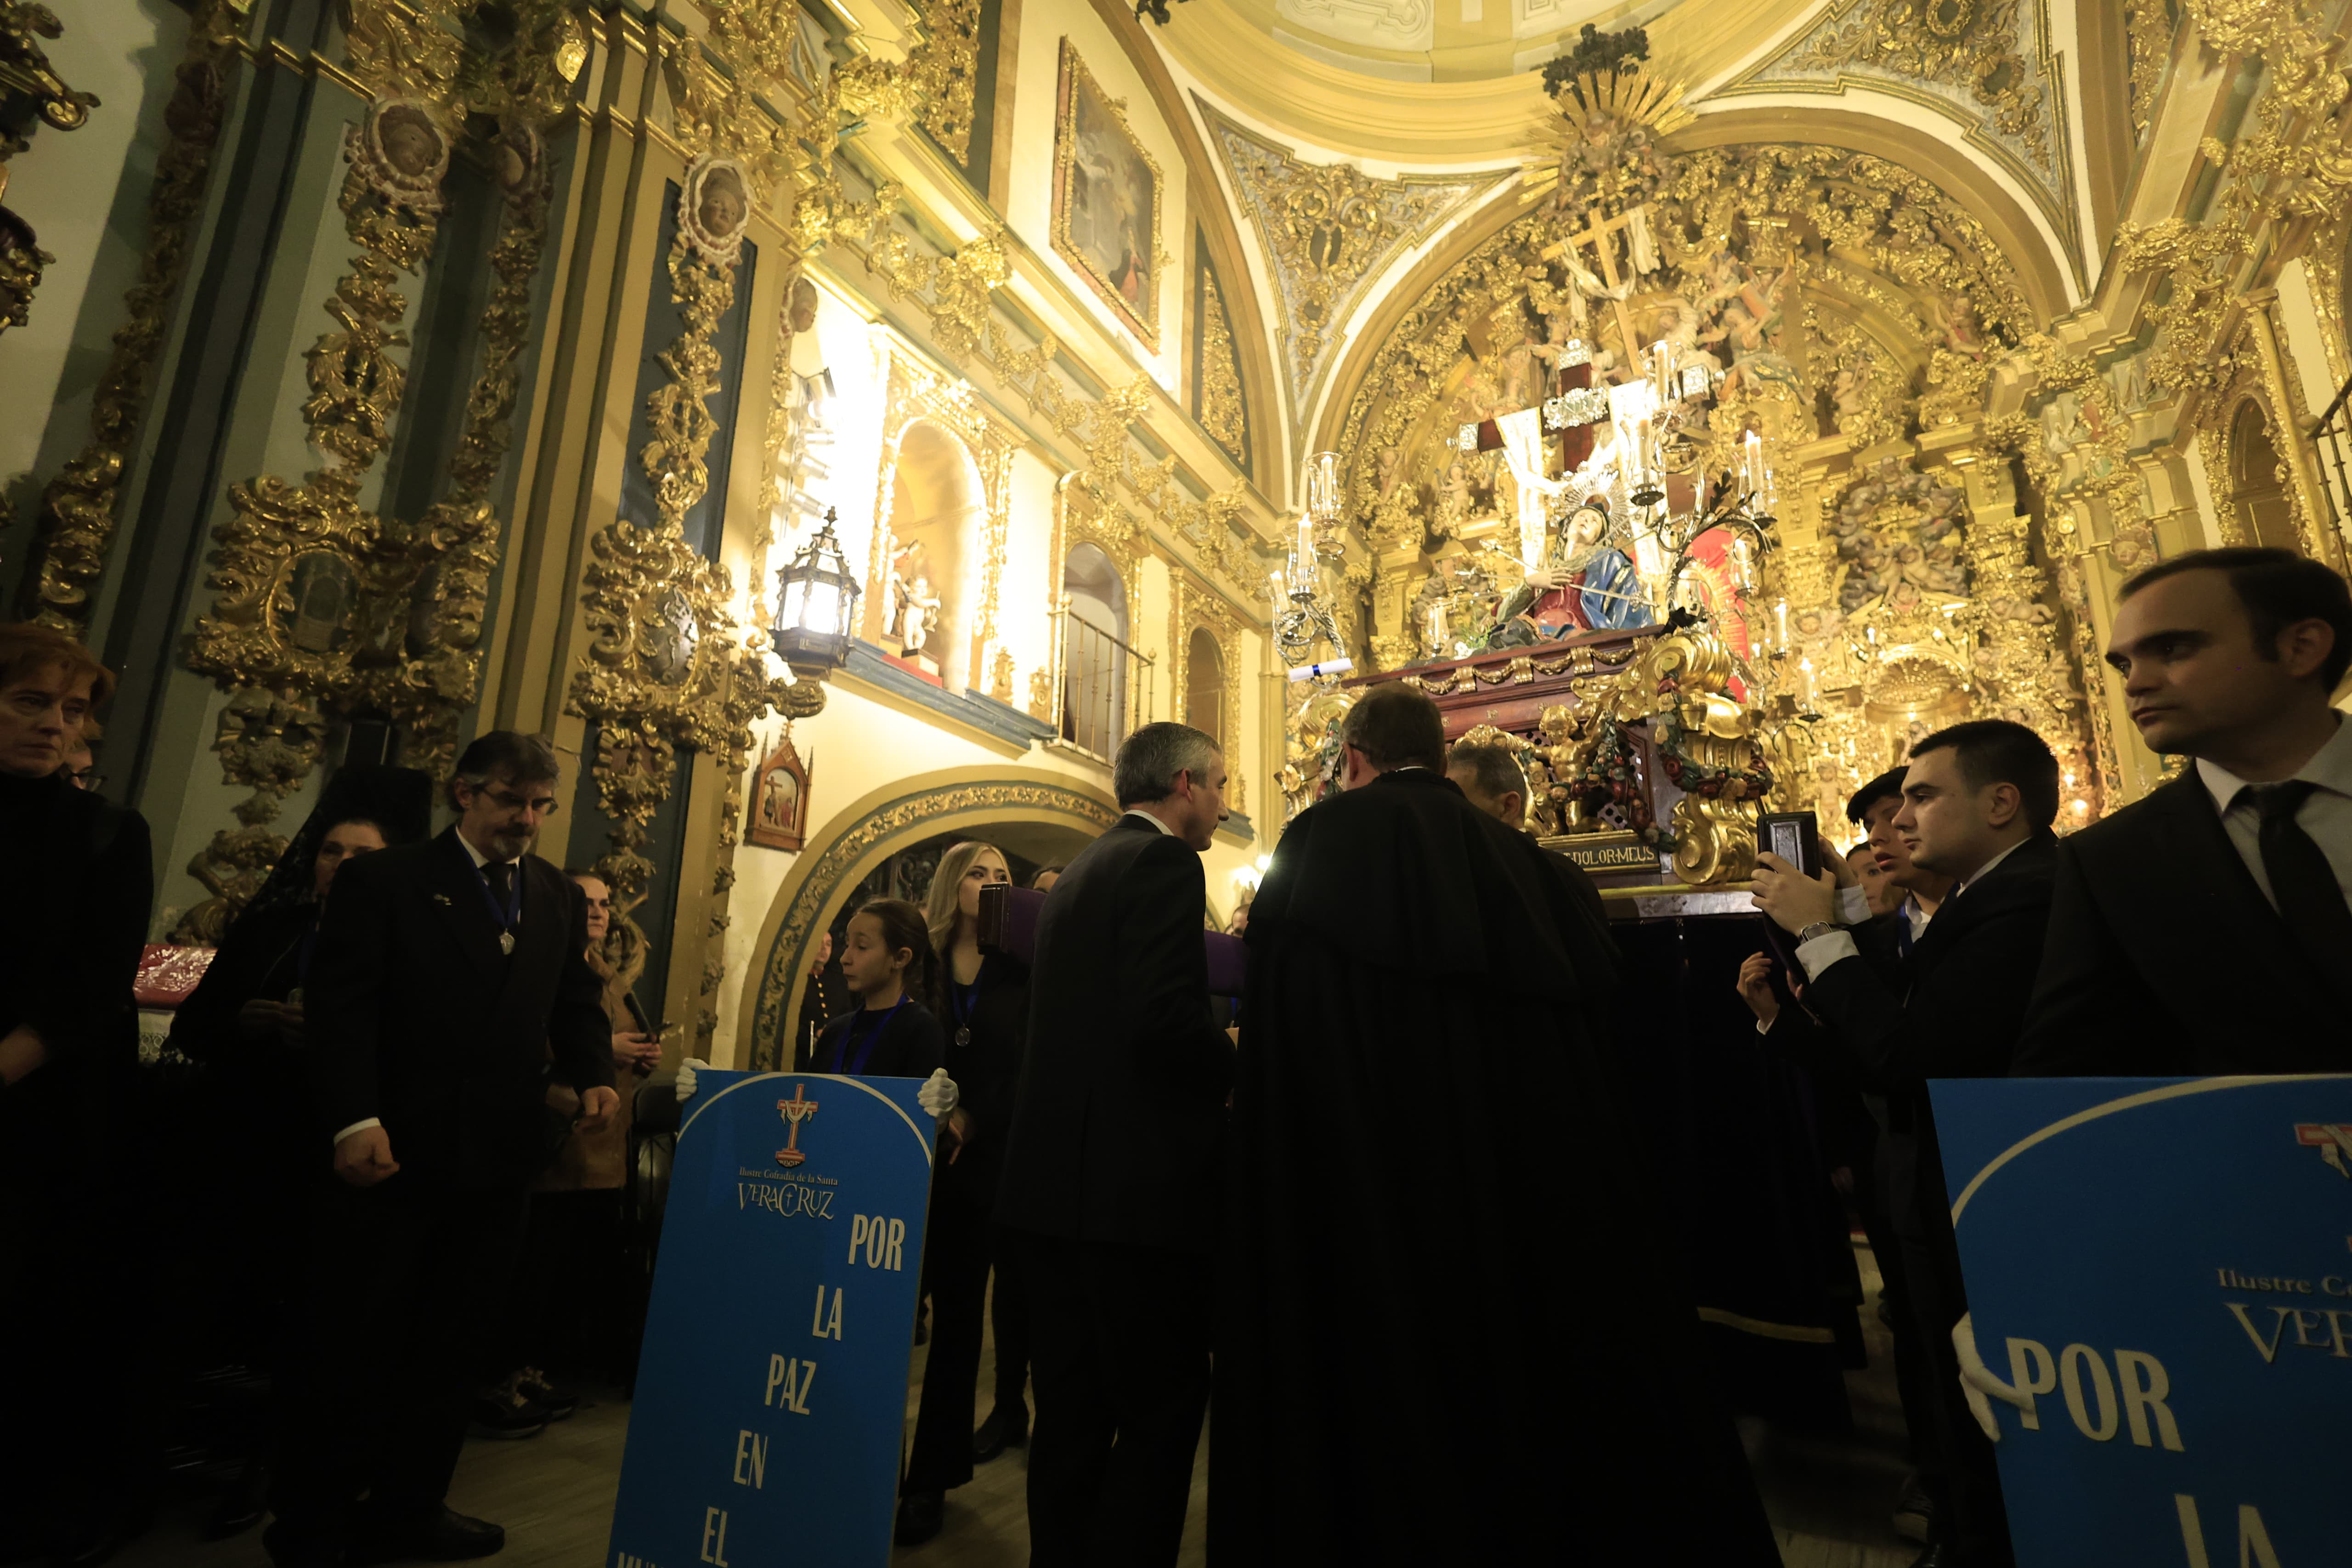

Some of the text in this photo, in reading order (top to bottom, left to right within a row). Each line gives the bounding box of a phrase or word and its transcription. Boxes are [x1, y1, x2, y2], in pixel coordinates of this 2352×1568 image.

[739, 1166, 761, 1177] Ilustre
[797, 1174, 806, 1183] de
[808, 1173, 814, 1183] la
[817, 1174, 838, 1185] Santa
[848, 1214, 905, 1271] POR
[2217, 1268, 2312, 1294] Ilustre
[813, 1285, 842, 1341] LA
[765, 1353, 816, 1415] PAZ
[2006, 1337, 2185, 1452] POR
[734, 1429, 768, 1489] EN
[701, 1506, 728, 1568] EL
